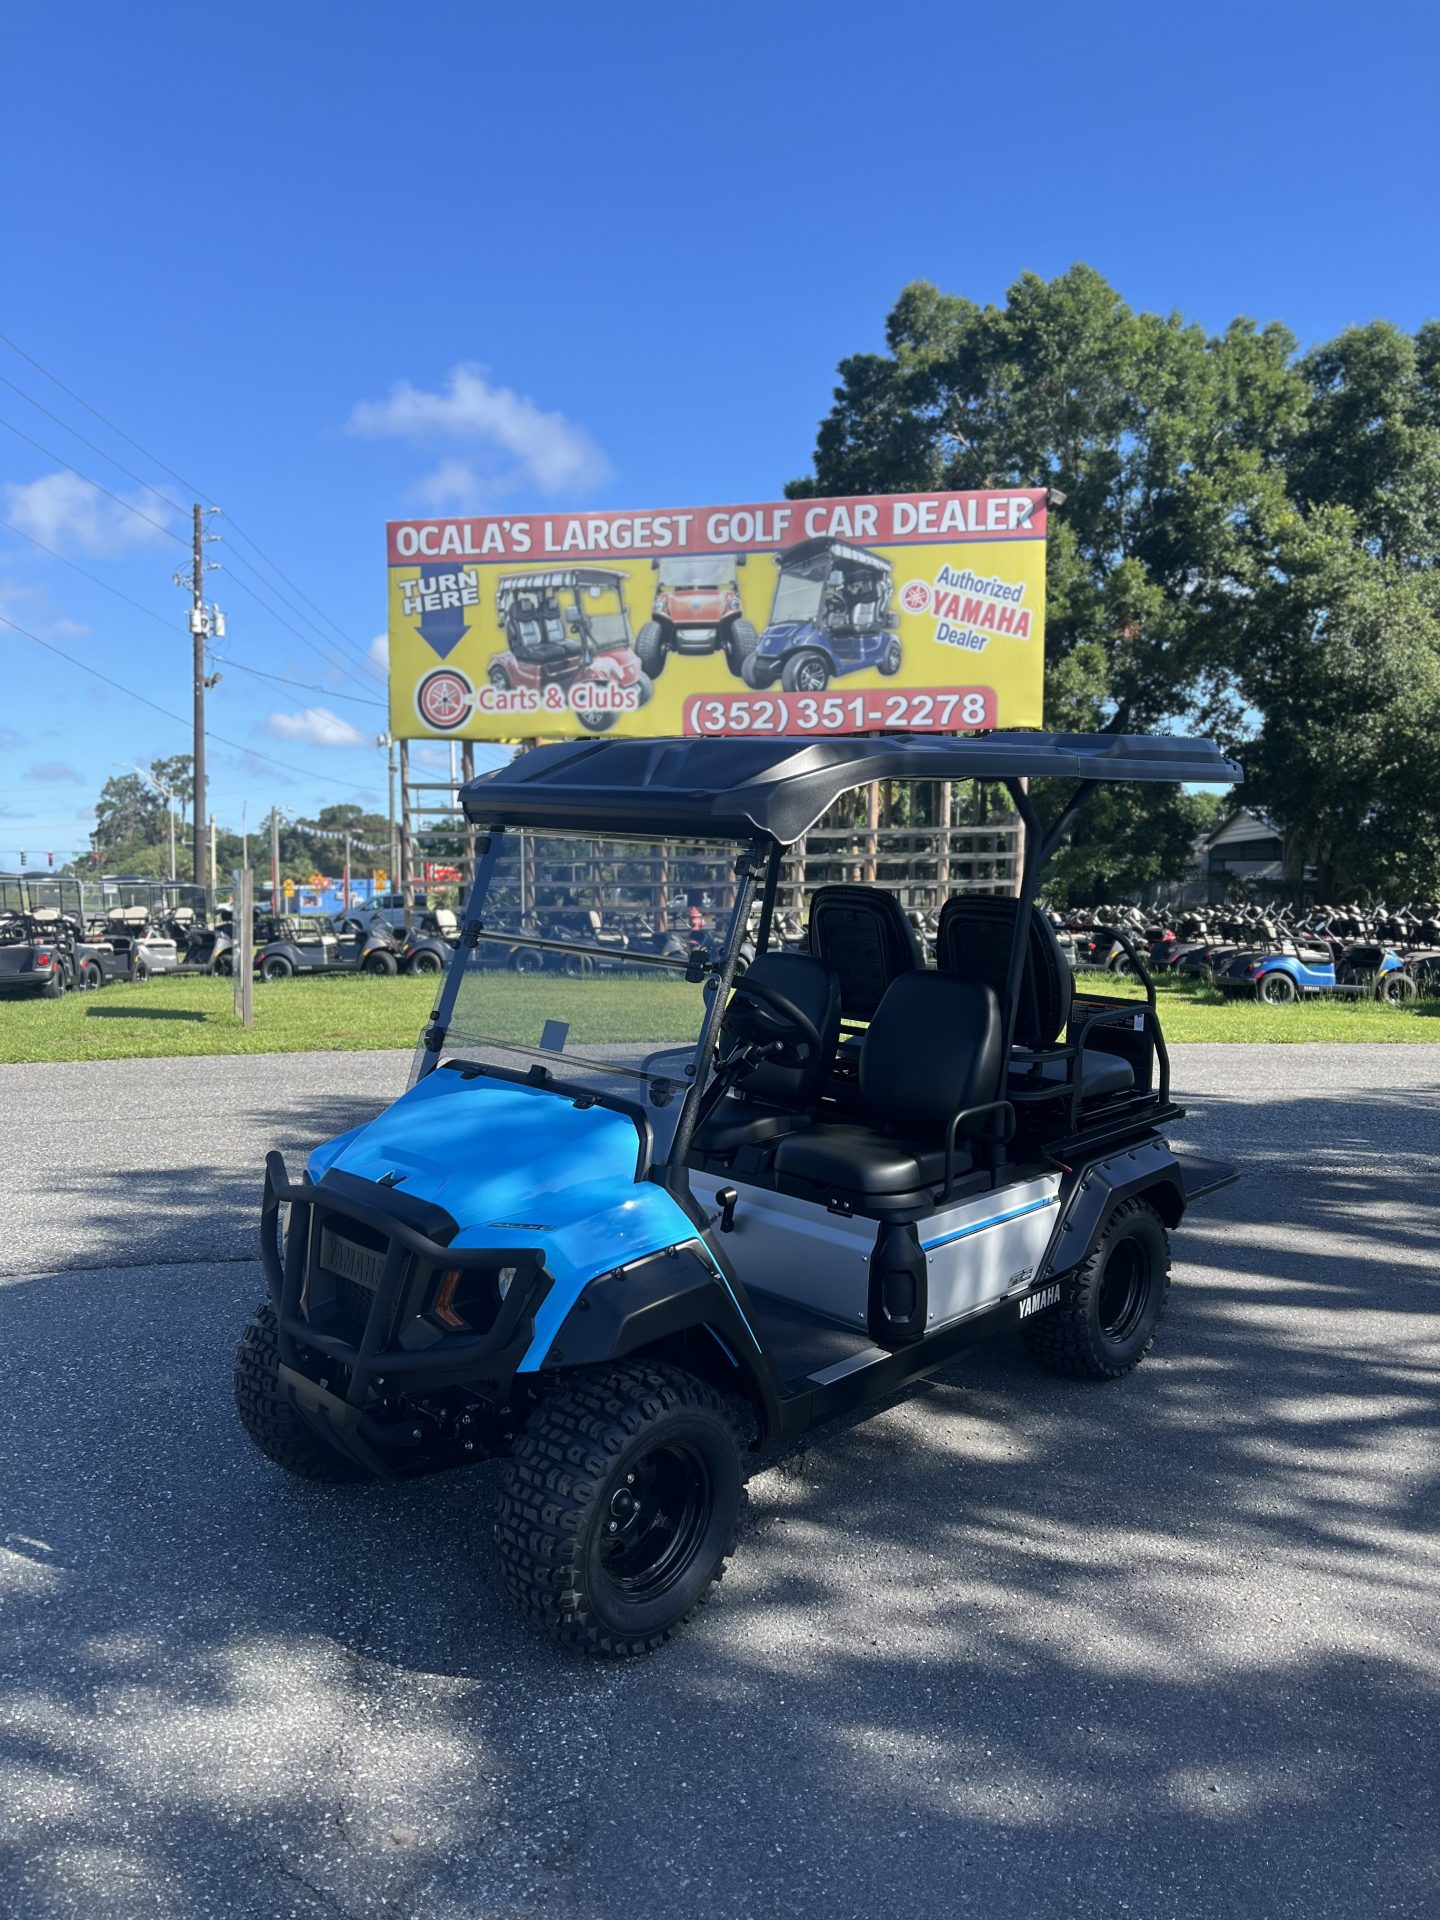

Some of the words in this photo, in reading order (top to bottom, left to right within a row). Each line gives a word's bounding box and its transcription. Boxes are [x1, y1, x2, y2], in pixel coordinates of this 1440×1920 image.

[396, 520, 533, 557] OCALA'S
[544, 514, 694, 552] LARGEST
[706, 508, 792, 545] GOLF
[804, 504, 878, 539] CAR
[892, 496, 1034, 535] DEALER
[399, 569, 479, 598] TURN
[403, 587, 480, 615] HERE
[936, 565, 1024, 603] Authorized
[932, 590, 1030, 637] YAMAHA
[936, 622, 988, 651] Dealer
[479, 687, 538, 711] Carts
[545, 687, 563, 709] &
[571, 685, 638, 709] Clubs
[690, 700, 789, 733] (352)
[796, 693, 986, 729] 351-2278
[1018, 1283, 1061, 1319] YAMAHA
